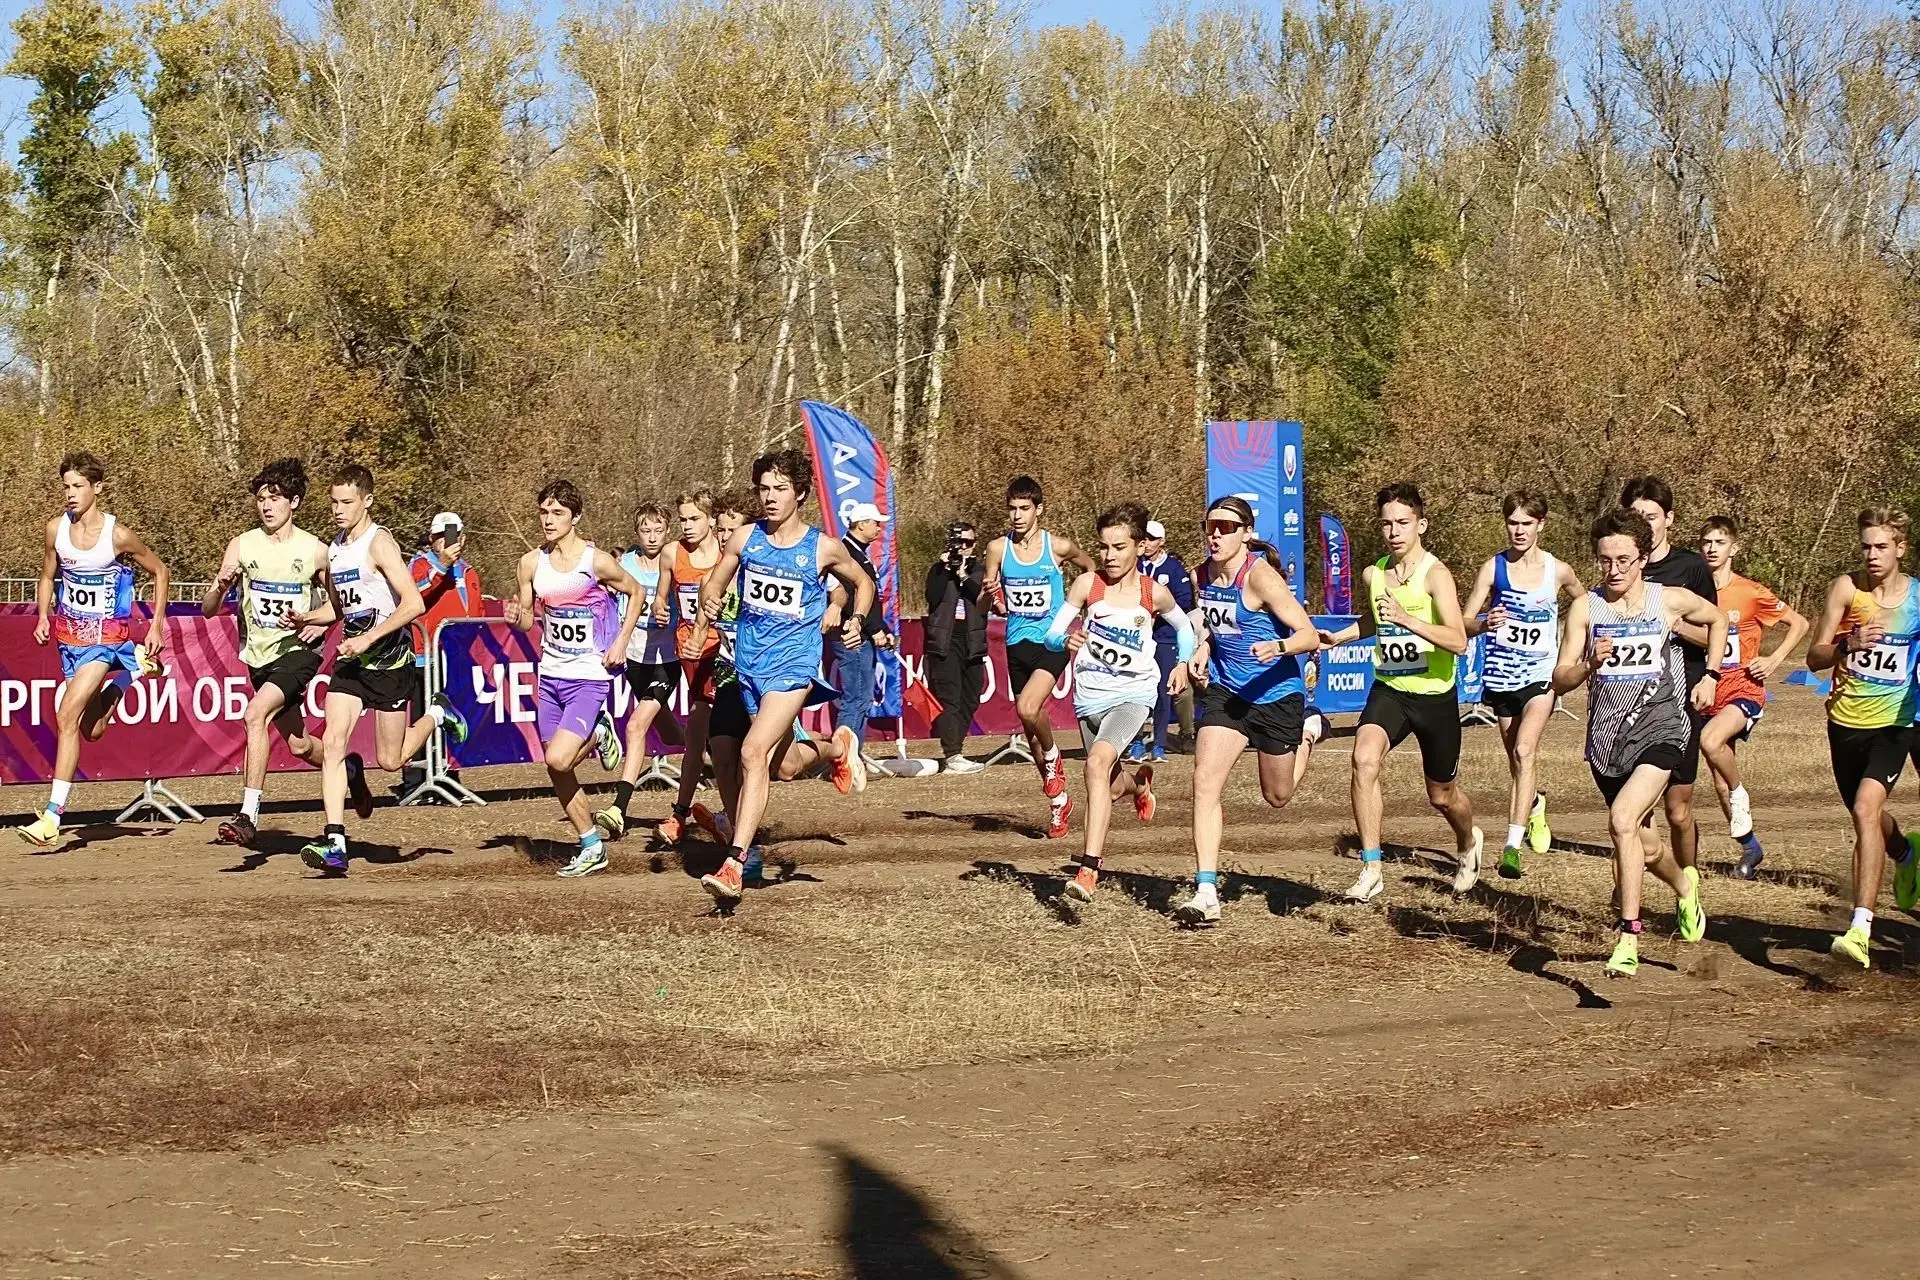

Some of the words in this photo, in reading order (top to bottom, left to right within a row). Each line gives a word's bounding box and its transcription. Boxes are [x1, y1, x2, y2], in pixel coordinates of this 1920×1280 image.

[68, 585, 96, 607] 301
[340, 588, 362, 608] 24
[749, 579, 794, 606] 303
[1012, 590, 1045, 607] 323
[1201, 606, 1233, 629] 304
[550, 621, 587, 643] 305
[1506, 625, 1541, 645] 319
[1328, 645, 1375, 664] МИНСПОРТ
[1380, 642, 1420, 663] 308
[1606, 643, 1652, 668] 322
[1328, 673, 1365, 691] РОССИИ
